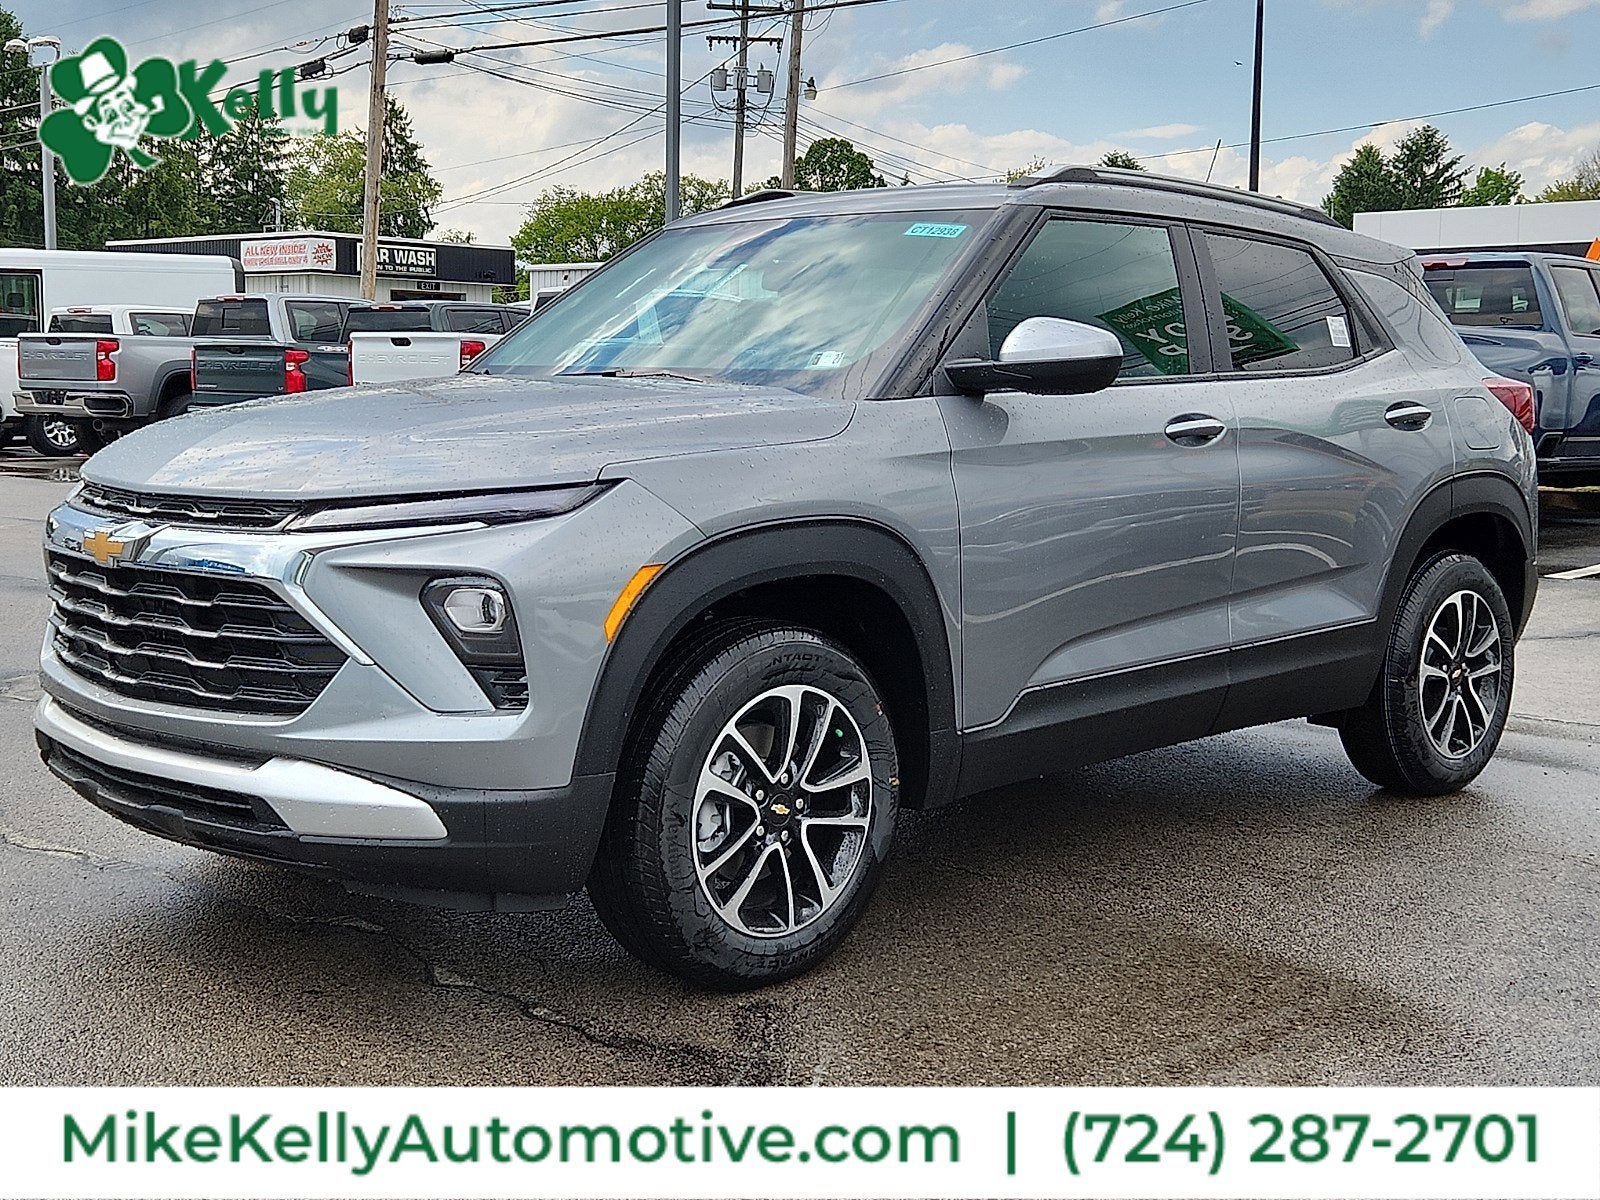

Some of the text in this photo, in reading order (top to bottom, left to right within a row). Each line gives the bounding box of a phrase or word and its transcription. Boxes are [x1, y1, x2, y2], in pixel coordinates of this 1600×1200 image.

[245, 246, 259, 257] ALL
[260, 245, 278, 256] NEW
[393, 249, 435, 266] WASH
[409, 266, 433, 274] PUBLIC
[421, 282, 436, 290] EXIT
[22, 350, 91, 360] CHEVROLET
[359, 354, 451, 365] CHEVROLET
[198, 360, 278, 371] CHEVROLET
